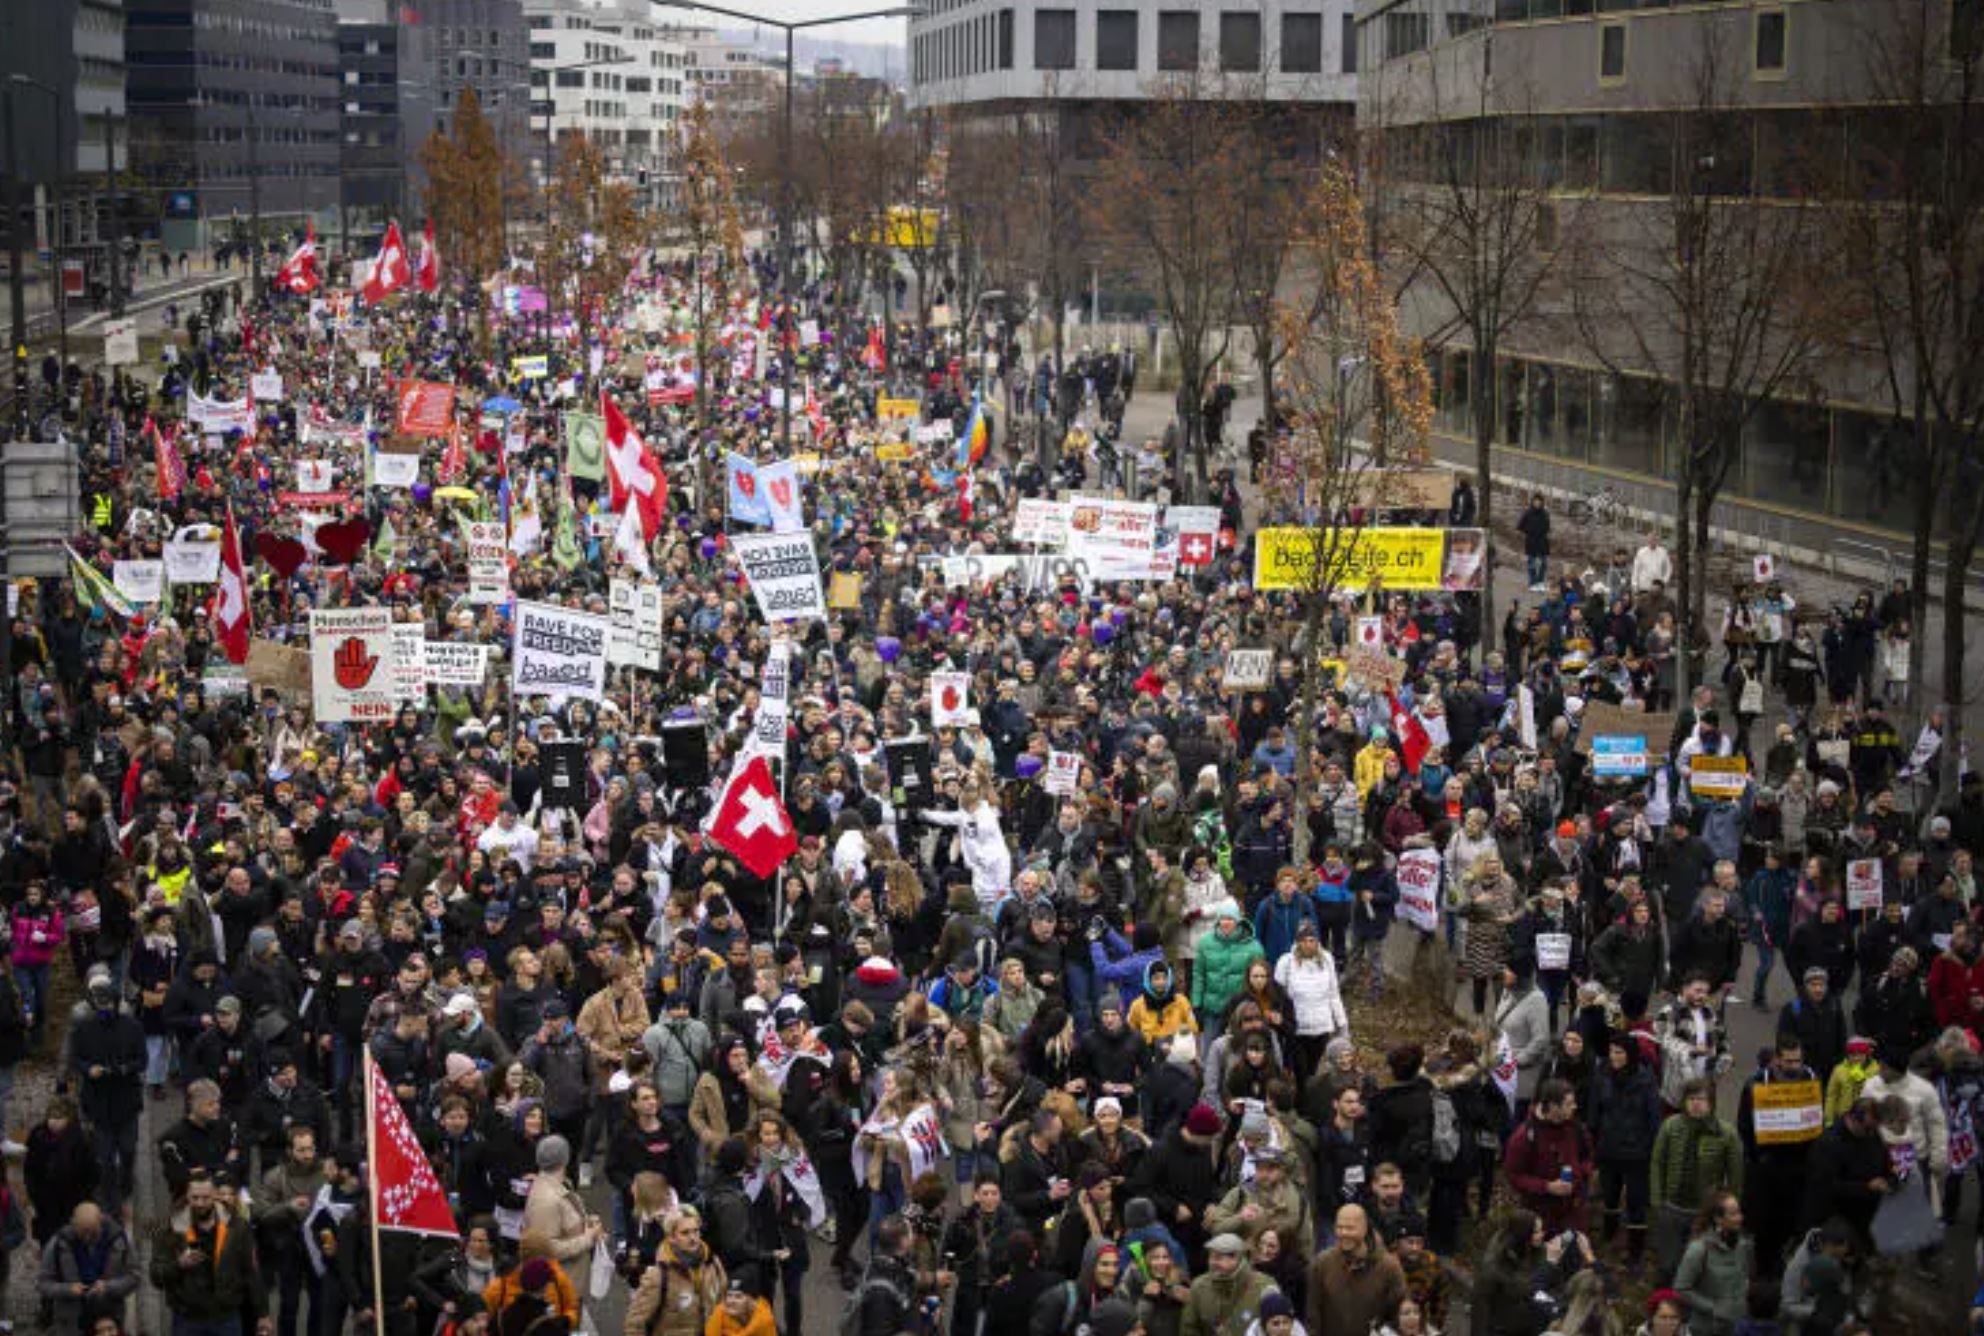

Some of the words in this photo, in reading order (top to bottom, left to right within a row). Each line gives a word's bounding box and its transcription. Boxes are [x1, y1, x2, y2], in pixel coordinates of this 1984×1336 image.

[524, 613, 567, 636] RAVE
[521, 655, 592, 681] based
[350, 702, 392, 718] NEIN
